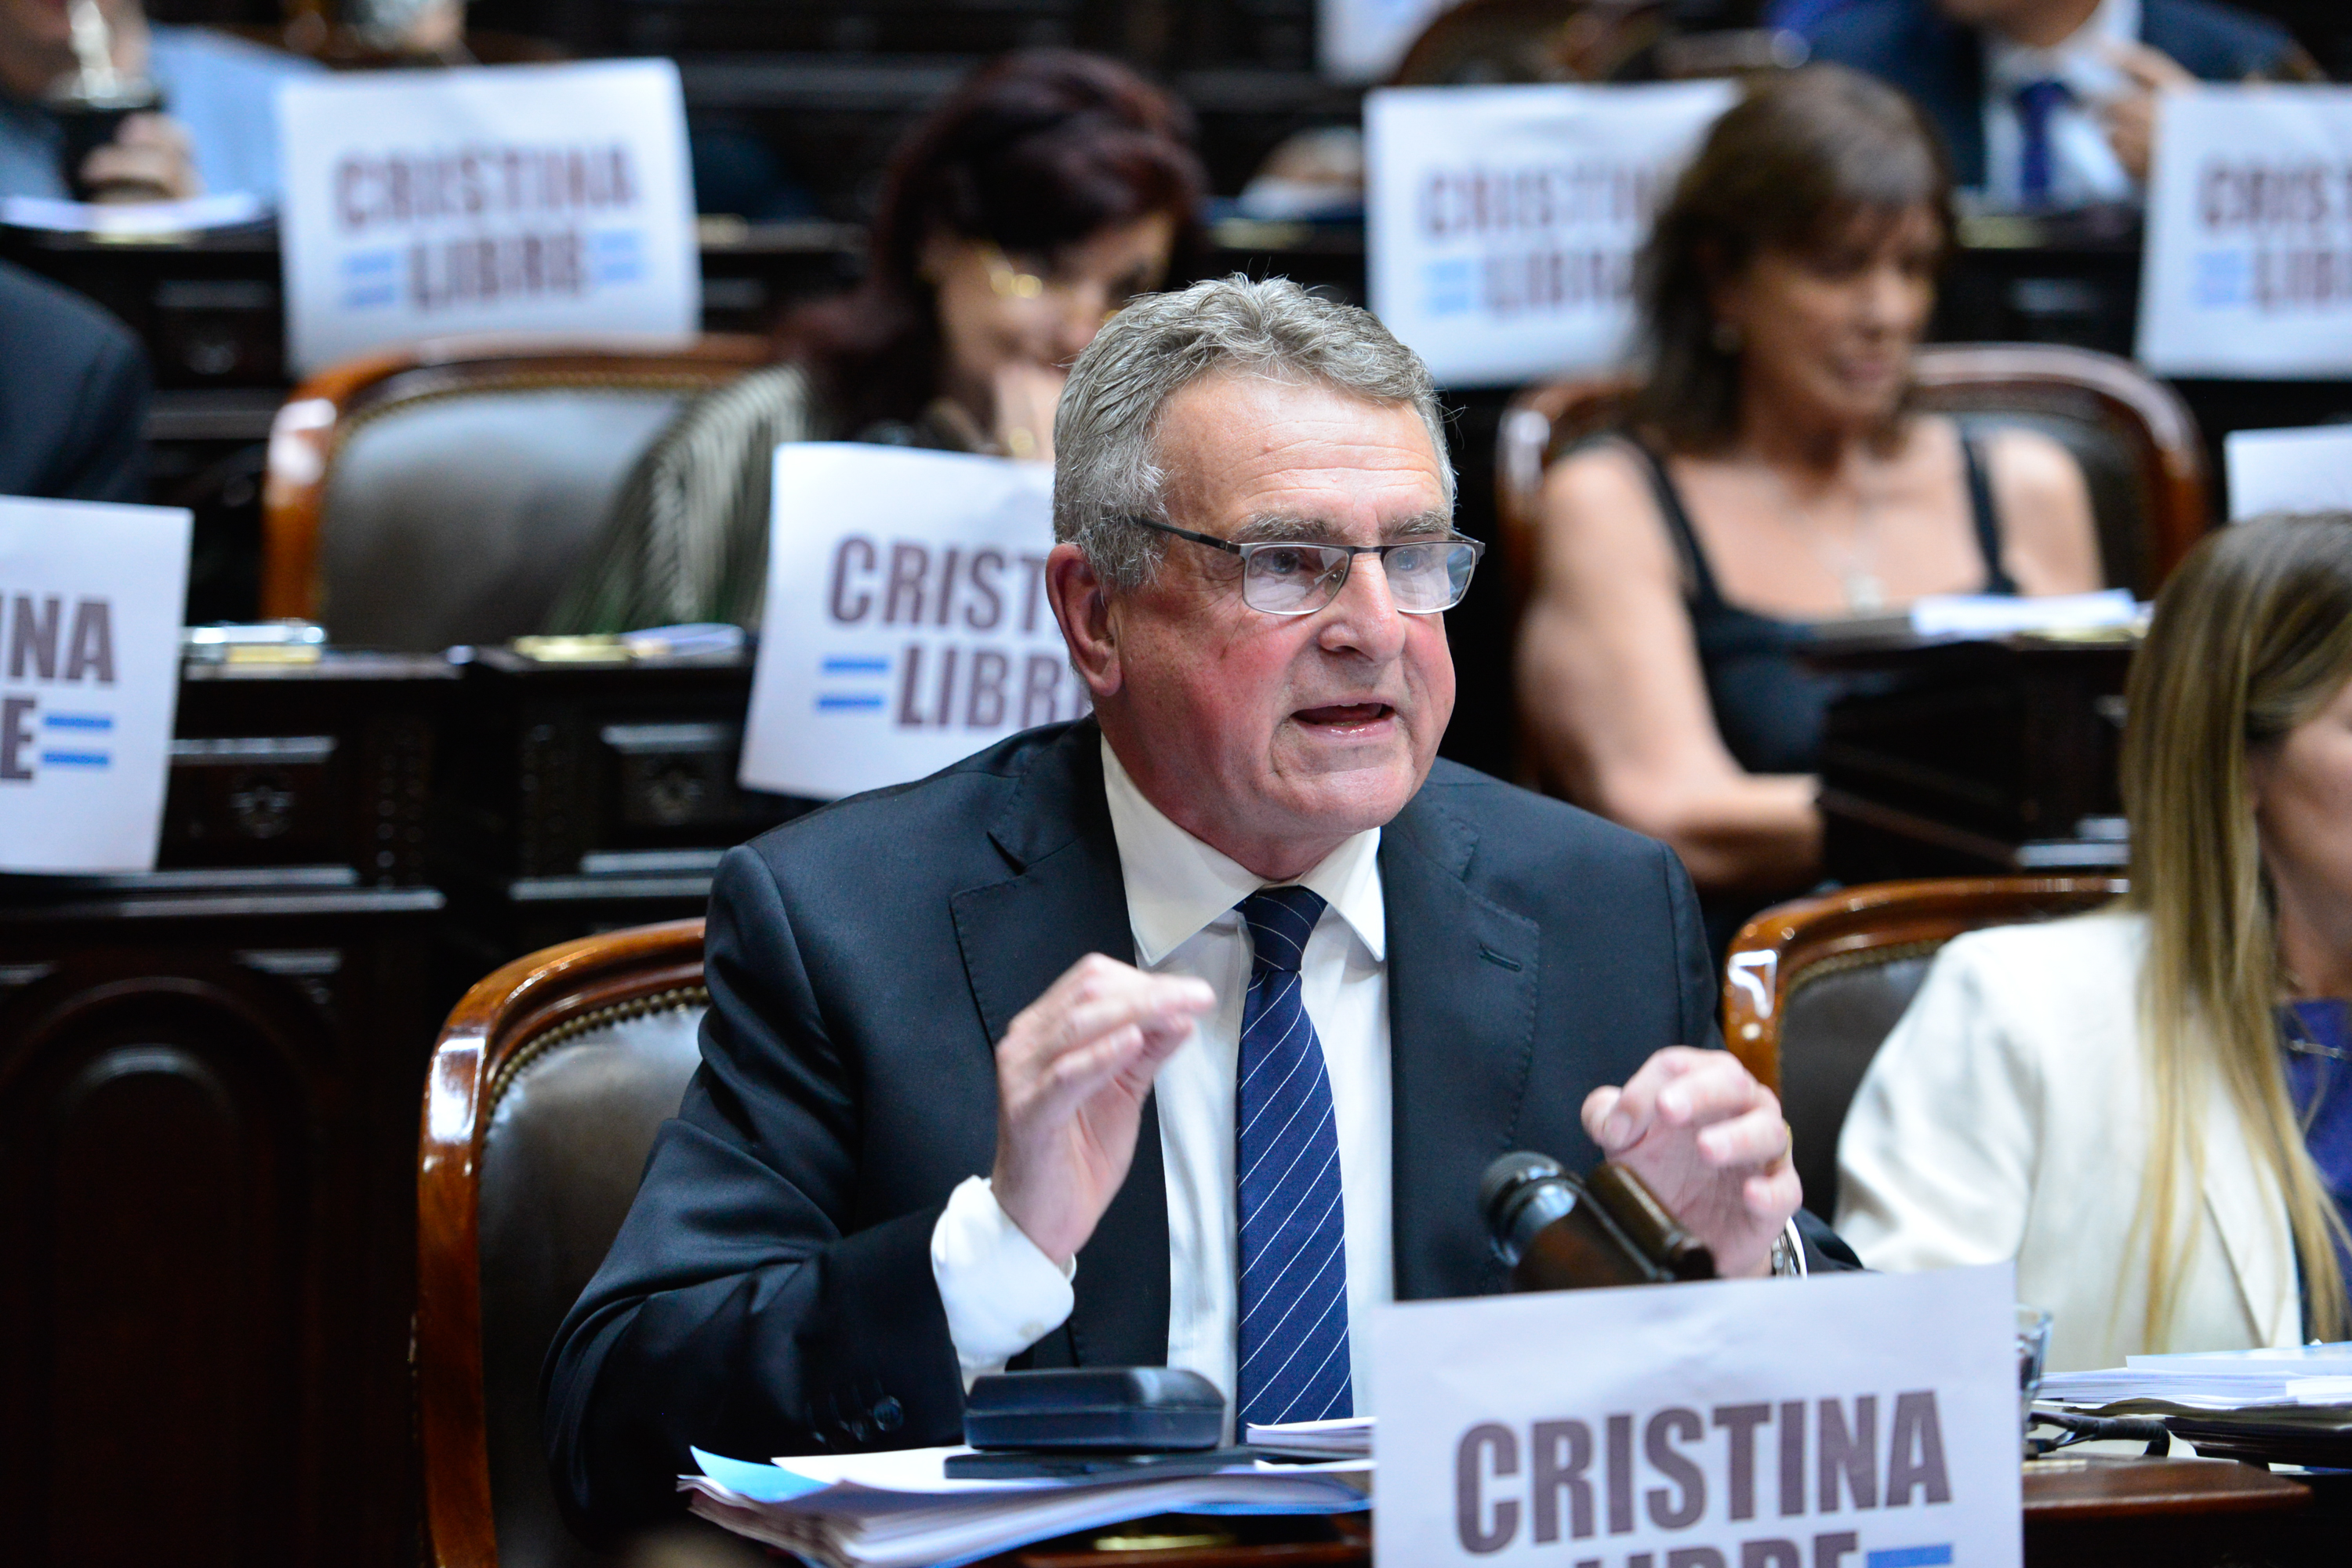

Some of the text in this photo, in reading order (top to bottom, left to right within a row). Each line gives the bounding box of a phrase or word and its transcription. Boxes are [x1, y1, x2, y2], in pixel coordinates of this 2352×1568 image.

[1417, 168, 1658, 237] CRISTIN
[829, 535, 1062, 633] CRIST
[0, 593, 115, 683] NA
[896, 644, 1085, 729] LIBR
[1456, 1389, 1952, 1555] CRISTINA
